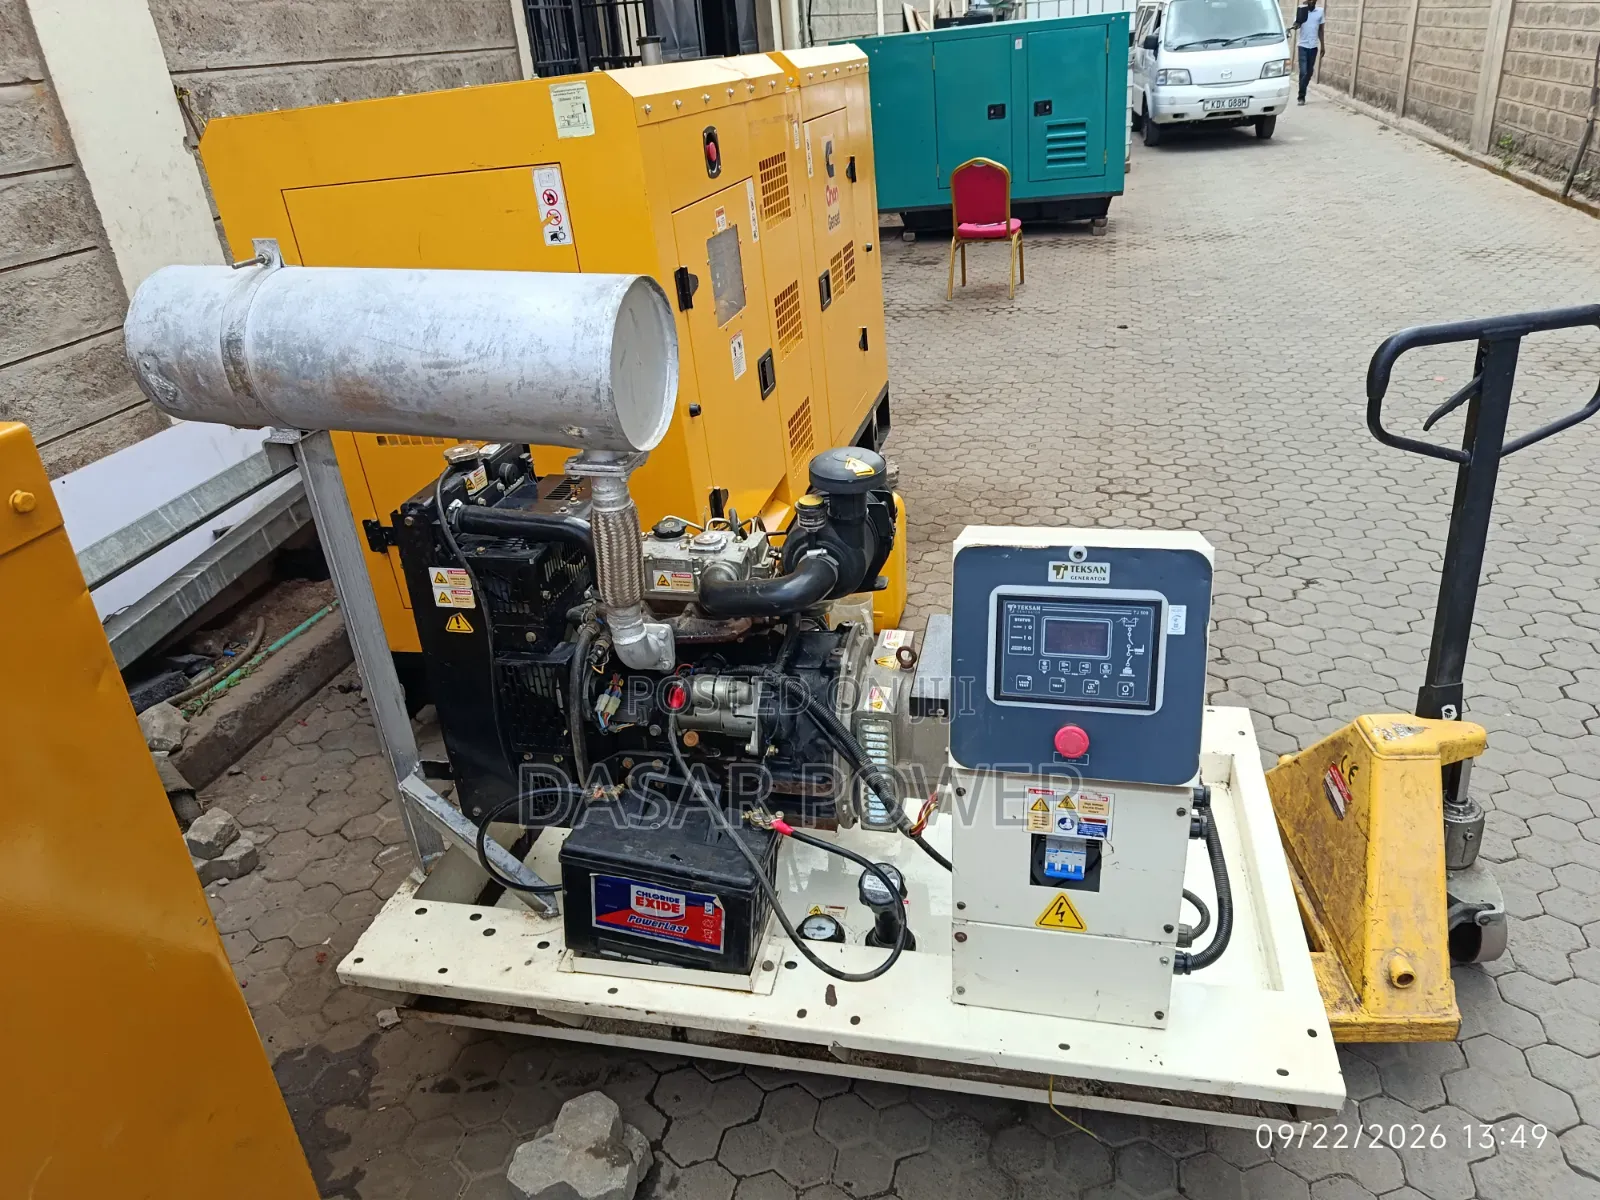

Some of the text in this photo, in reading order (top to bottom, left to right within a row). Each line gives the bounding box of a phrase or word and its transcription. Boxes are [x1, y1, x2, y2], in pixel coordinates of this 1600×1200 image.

[1070, 565, 1107, 574] TEKSAN
[634, 895, 681, 914] EXIDE
[635, 890, 680, 903] CHLORIDE
[627, 914, 690, 934] PowerLast
